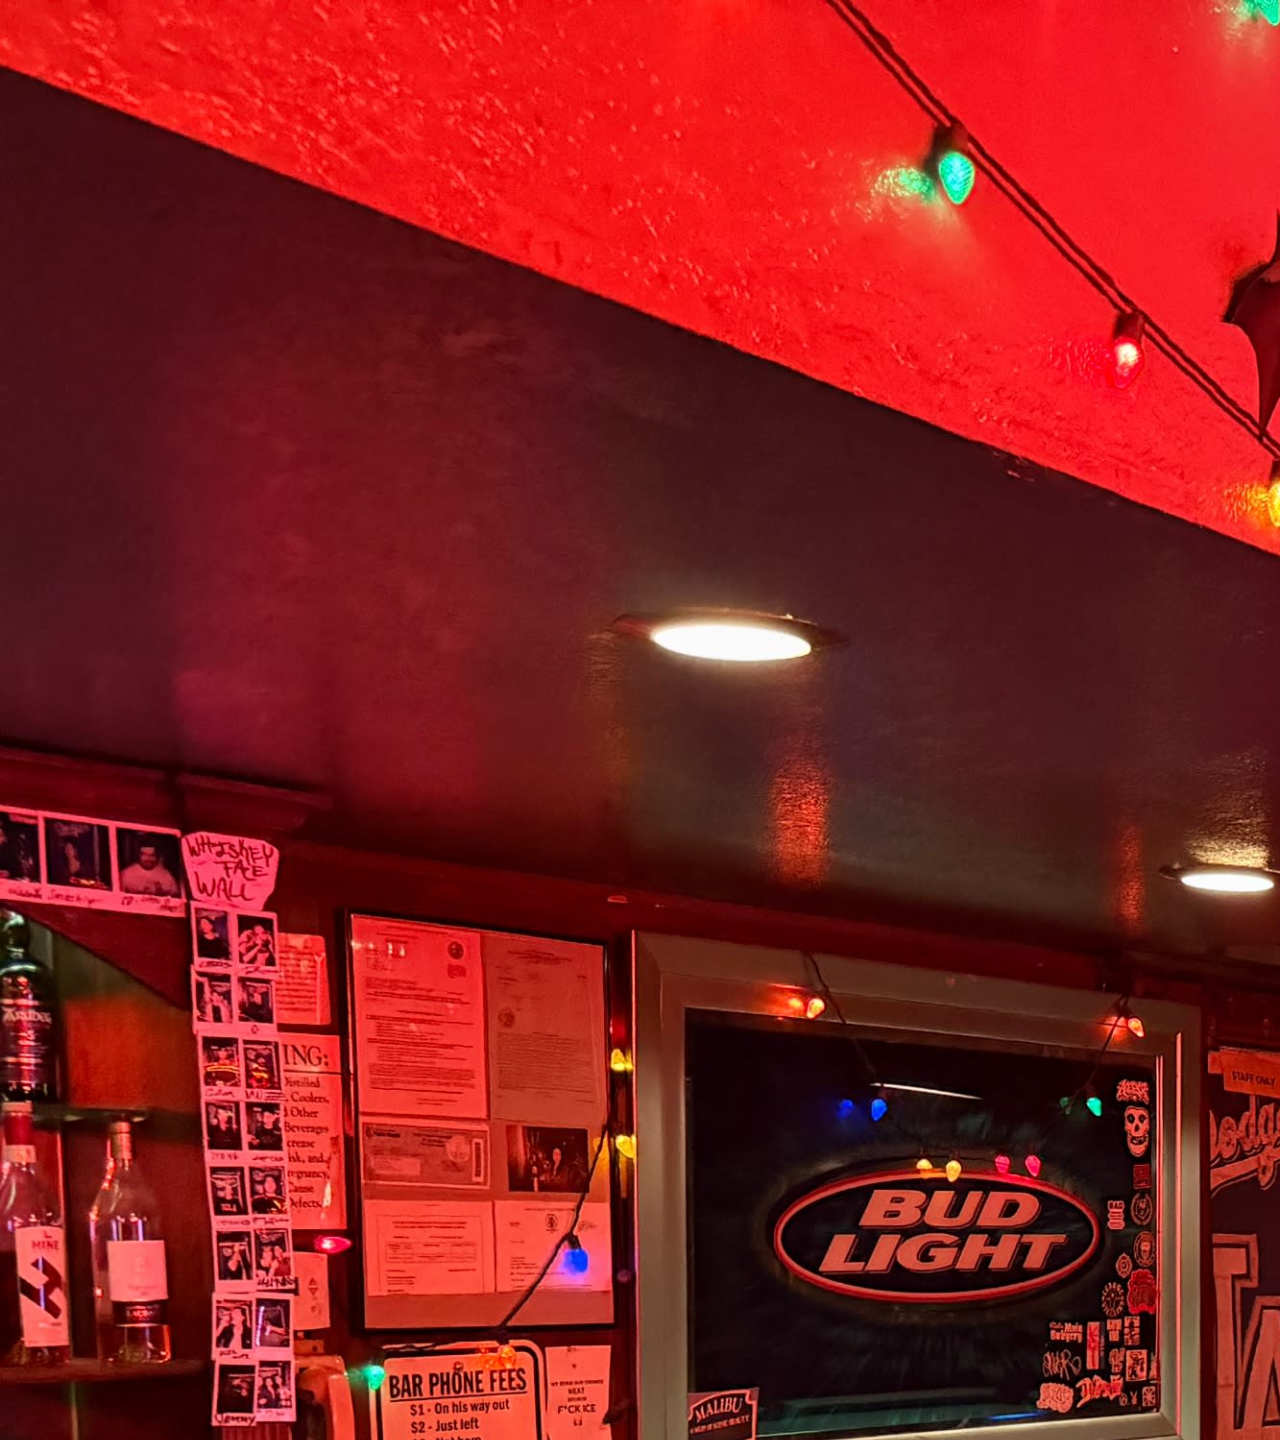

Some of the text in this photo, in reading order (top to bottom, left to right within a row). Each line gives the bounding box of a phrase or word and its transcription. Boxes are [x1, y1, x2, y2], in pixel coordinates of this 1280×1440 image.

[185, 834, 274, 868] WHISKEY
[193, 871, 256, 901] WALL
[858, 1189, 1042, 1229] BUD
[818, 1233, 1067, 1273] LIGHT
[389, 1368, 527, 1398] BAR PHONE FEES
[410, 1399, 510, 1417] $1 On his way out
[695, 1397, 743, 1423] MALIBU
[411, 1418, 479, 1434] $2 Just left
